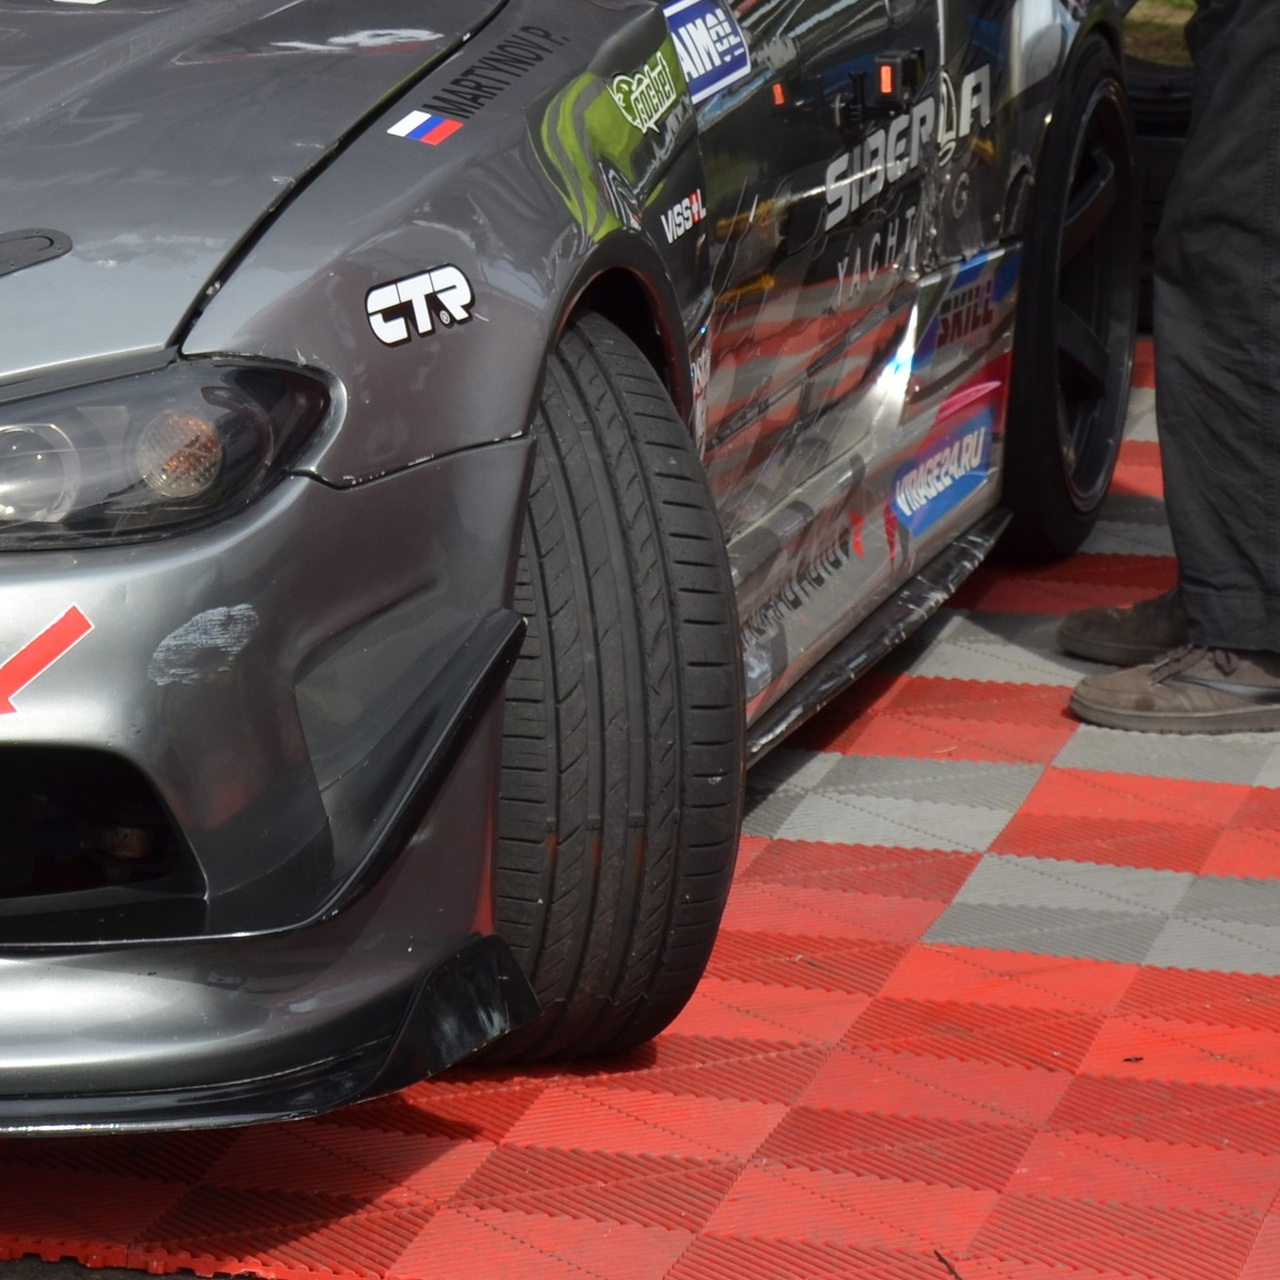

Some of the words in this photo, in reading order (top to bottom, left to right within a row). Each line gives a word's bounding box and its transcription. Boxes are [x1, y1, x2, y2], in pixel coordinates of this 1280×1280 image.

[421, 34, 553, 119] MARTYNOV
[520, 25, 572, 47] P.
[366, 265, 473, 344] CTR
